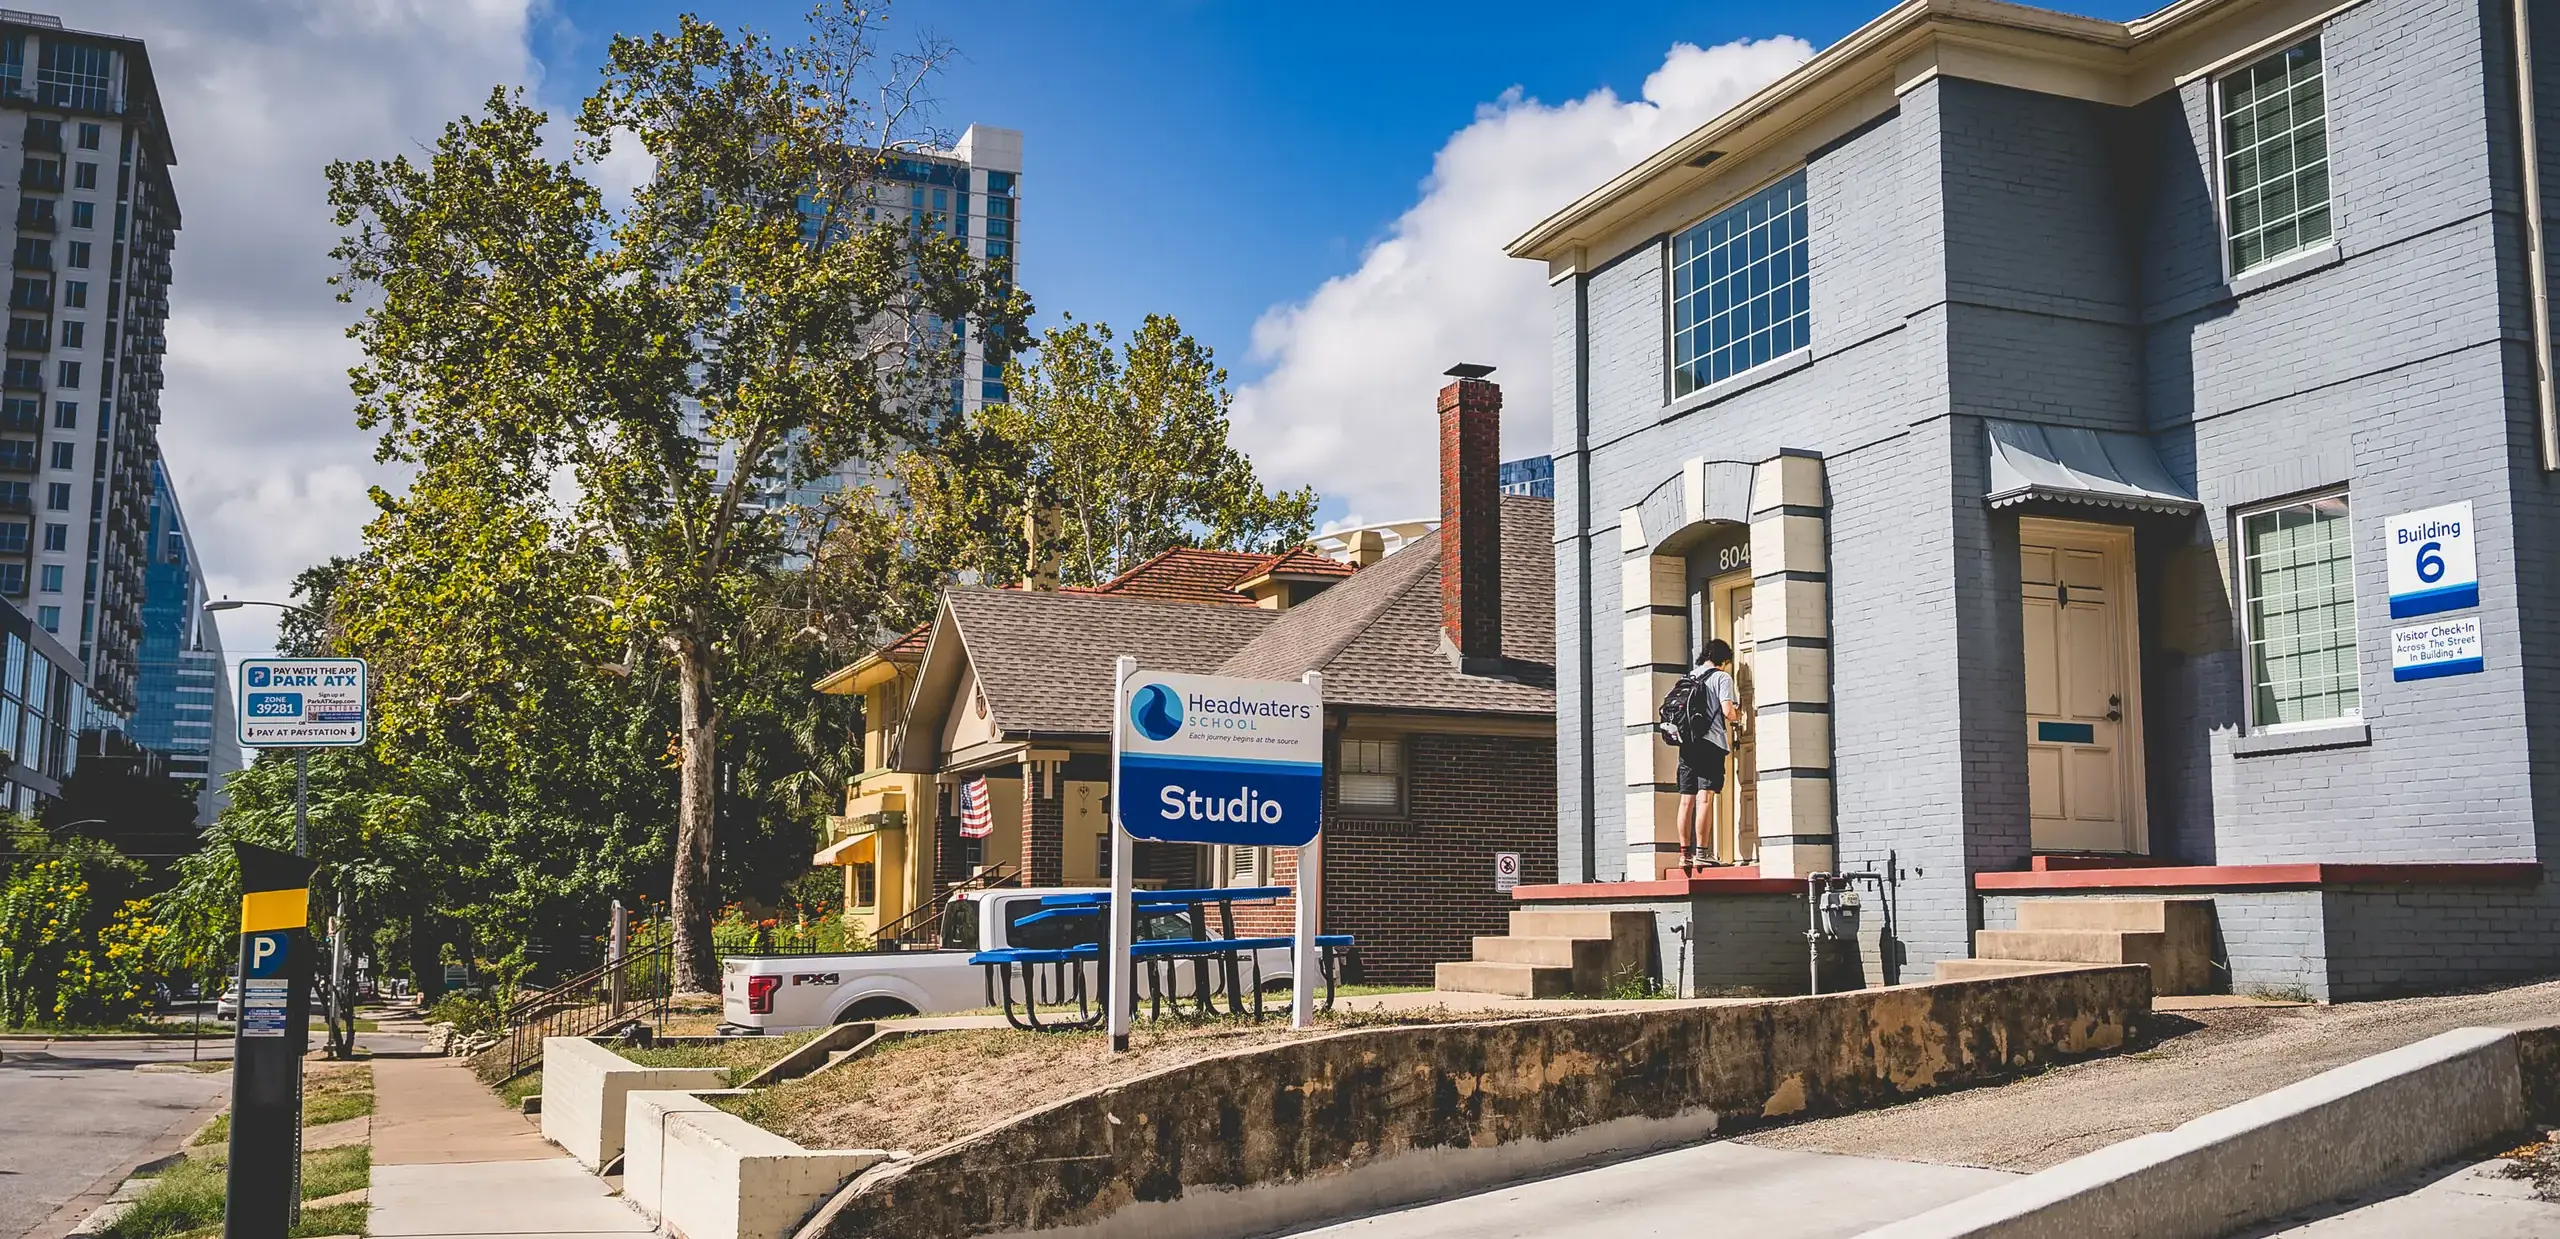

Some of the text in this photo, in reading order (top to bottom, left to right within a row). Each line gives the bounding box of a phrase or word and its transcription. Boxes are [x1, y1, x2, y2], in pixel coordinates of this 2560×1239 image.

[2398, 521, 2461, 544] Building
[1720, 543, 1751, 570] 804
[2415, 541, 2445, 583] 6
[2396, 623, 2475, 642] Visitor Check-In
[2397, 635, 2476, 653] Across The Street
[2410, 646, 2463, 661] In Building 4
[273, 667, 357, 675] PAY WITH THE APP
[273, 675, 357, 686] PARK ATX
[256, 703, 295, 714] 39281
[1189, 693, 1311, 719] Headwaters
[1189, 716, 1257, 731] SCHOOL
[290, 728, 347, 736] PAYSTATION
[1189, 732, 1206, 740] Each
[1206, 734, 1232, 742] journey
[1232, 735, 1254, 743] begins
[1160, 785, 1283, 824] Studio
[253, 937, 276, 969] P
[793, 972, 840, 986] FX4
